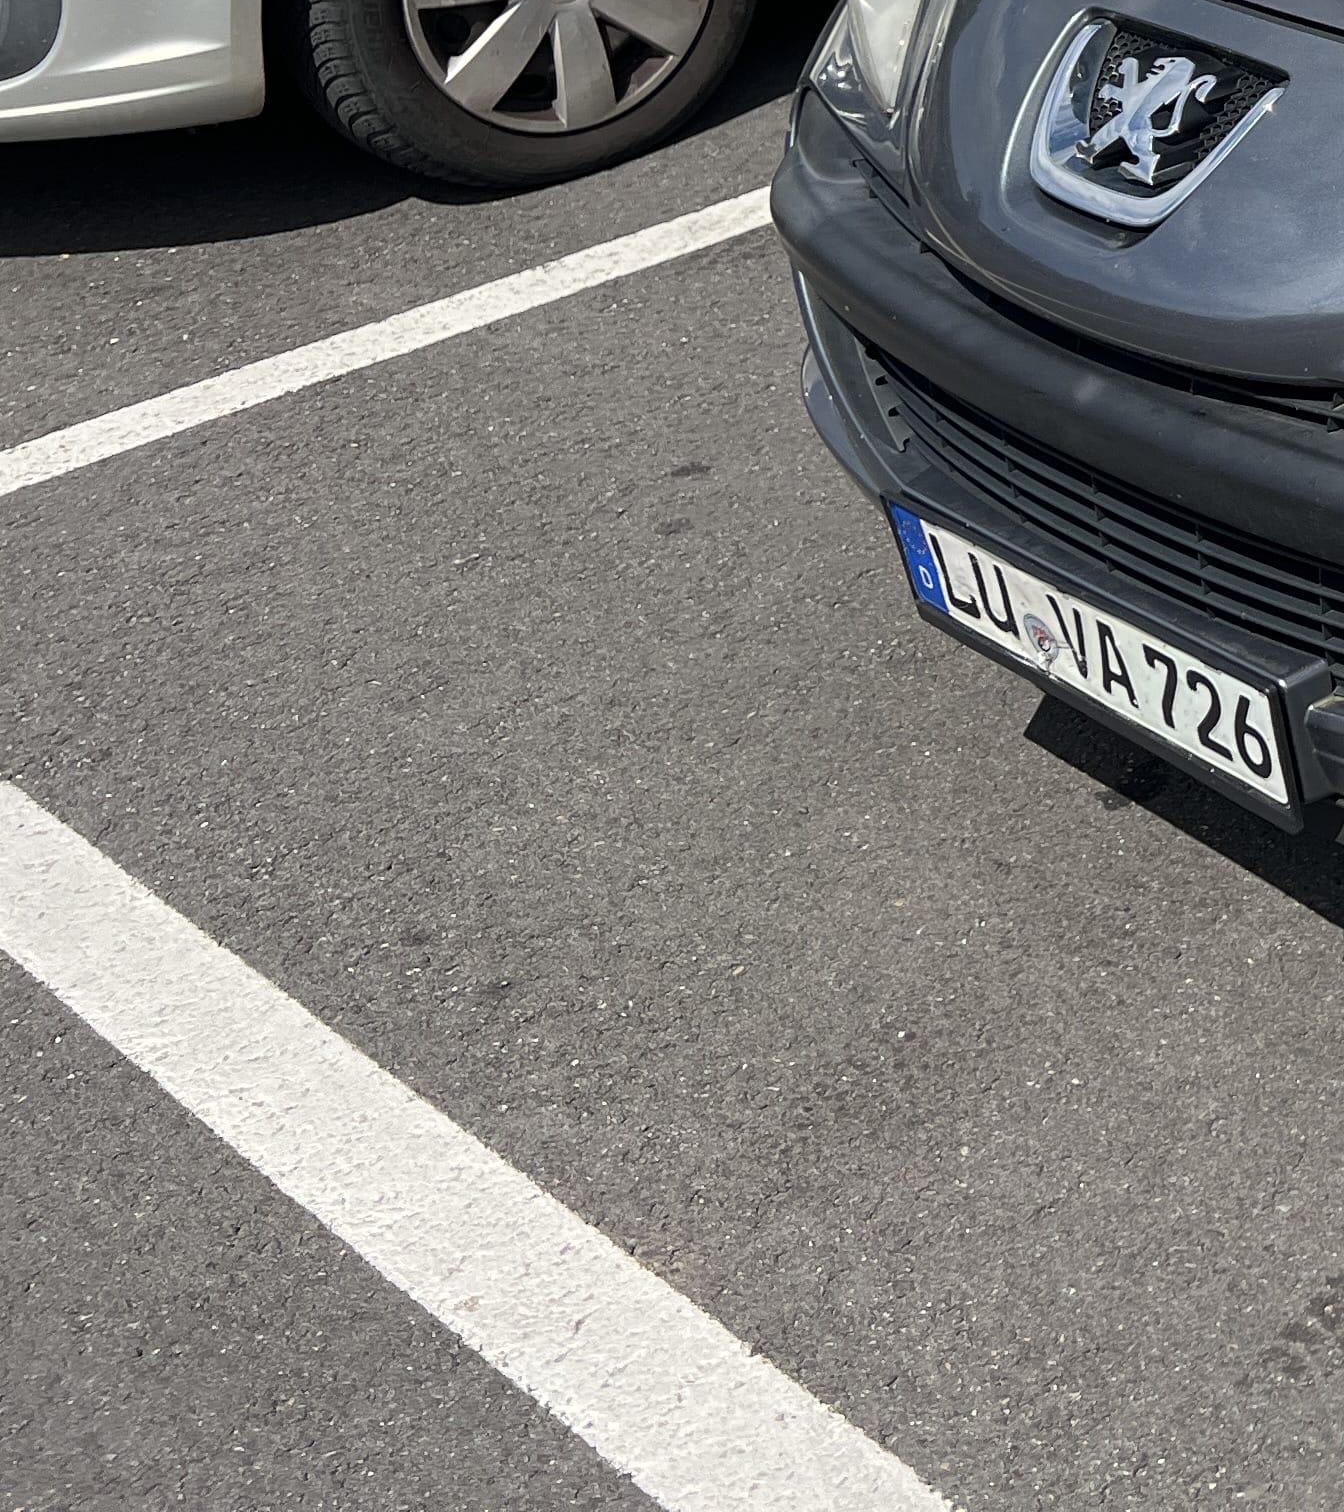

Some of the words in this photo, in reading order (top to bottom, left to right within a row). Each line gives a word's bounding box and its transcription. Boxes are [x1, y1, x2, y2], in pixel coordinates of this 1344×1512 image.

[918, 565, 933, 589] D
[928, 532, 1021, 640] LU
[1046, 594, 1139, 708] VA
[1143, 644, 1273, 779] 726
